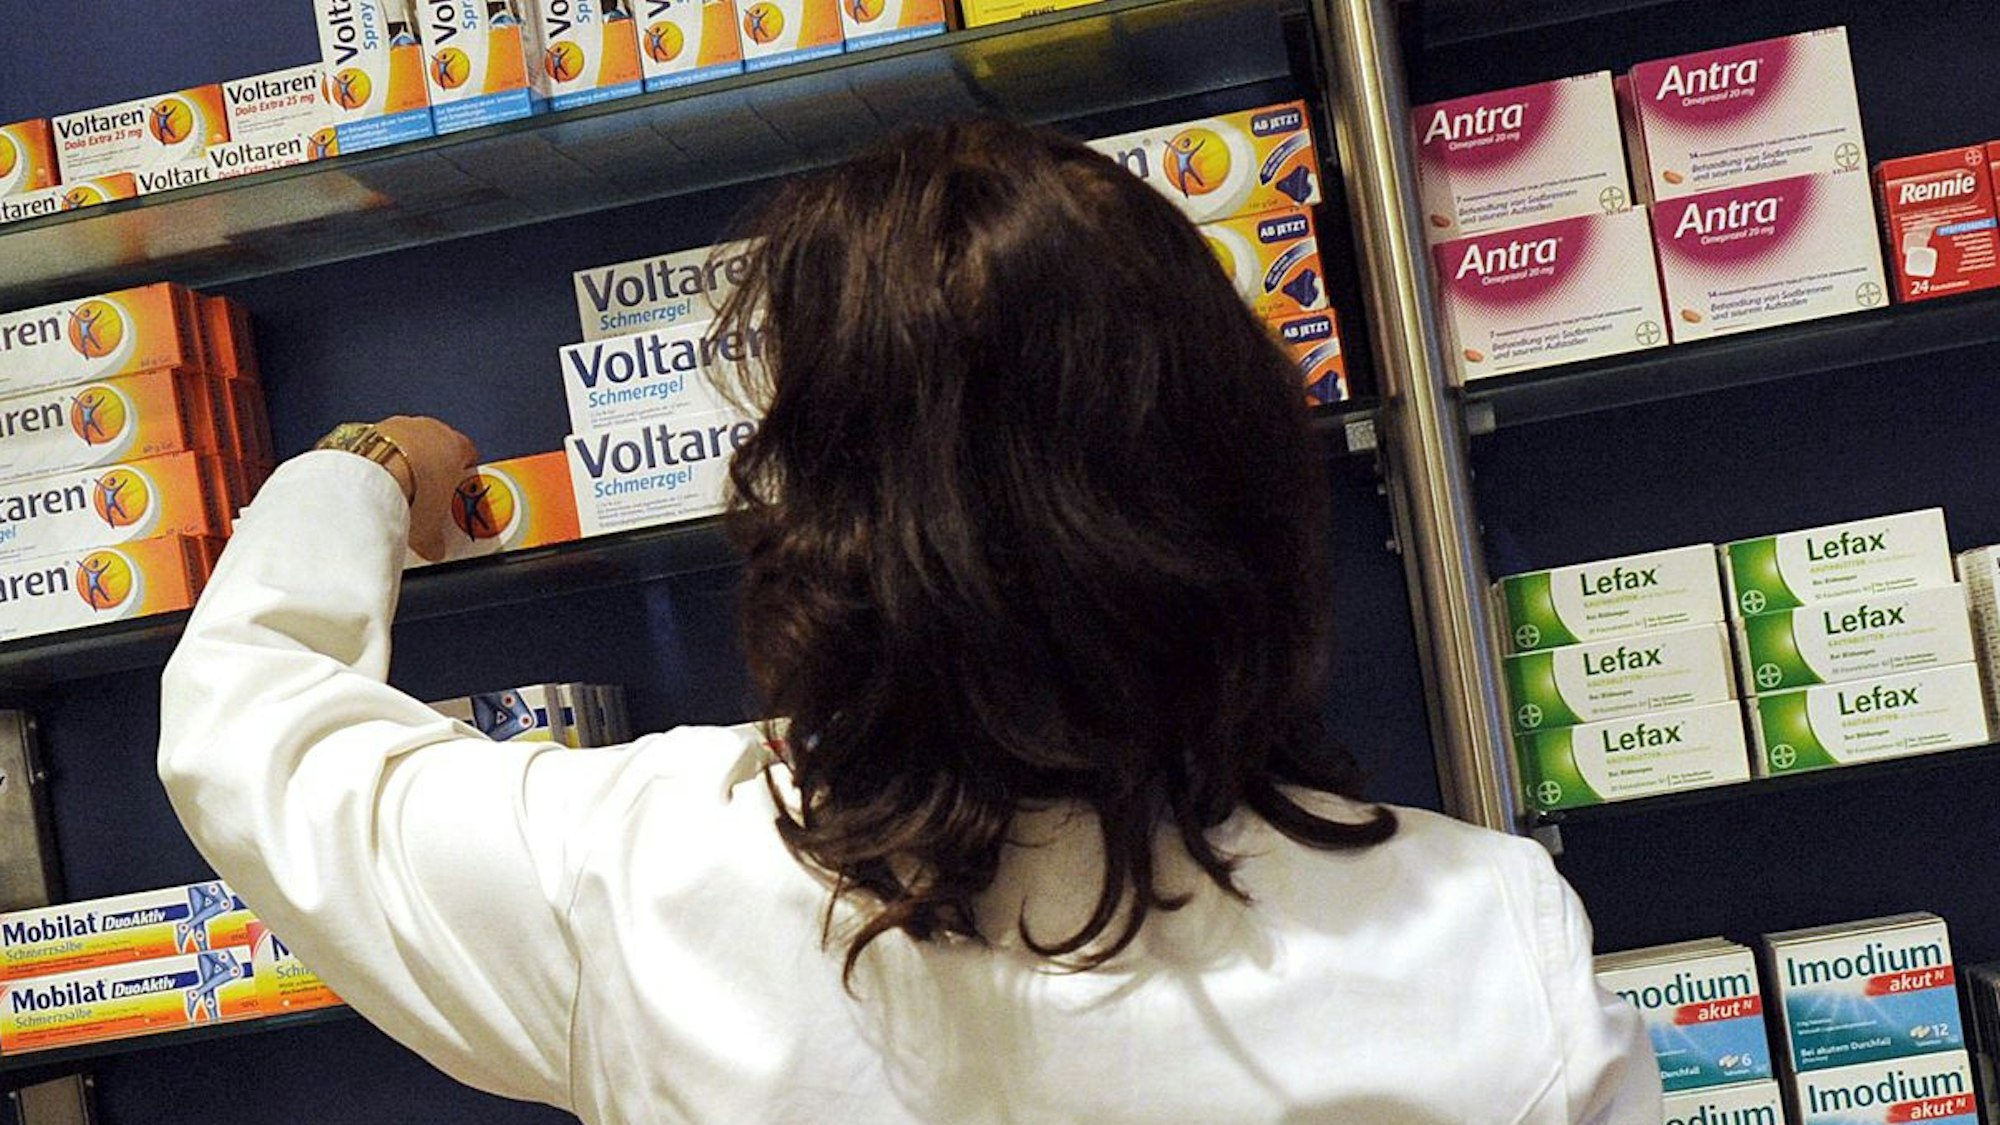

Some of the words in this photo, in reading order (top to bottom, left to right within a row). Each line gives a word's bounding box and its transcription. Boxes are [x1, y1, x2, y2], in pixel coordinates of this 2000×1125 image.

[360, 2, 379, 50] Spray
[462, 0, 478, 29] Spr
[328, 0, 358, 65] Volt
[228, 74, 316, 104] Voltaren
[1656, 58, 1758, 101] Antra
[260, 100, 284, 111] Extra
[287, 96, 298, 106] 25
[301, 93, 315, 104] mg
[57, 109, 144, 139] Voltaren
[88, 134, 112, 146] Extra
[115, 131, 126, 141] 25
[128, 128, 143, 139] mg
[1253, 118, 1269, 132] AB
[1271, 112, 1299, 128] JETZT
[1423, 103, 1524, 145] Antra
[210, 138, 301, 168] Voltaren
[1899, 171, 1976, 205] Rennie
[1260, 225, 1275, 238] AB
[1276, 219, 1306, 237] JETZT
[1673, 196, 1779, 240] Antra
[1455, 237, 1558, 280] Antra
[1910, 280, 1930, 295] 24
[600, 297, 691, 332] Schmerzgel
[1283, 325, 1298, 338] AB
[1299, 320, 1330, 337] JETZT
[0, 316, 61, 351] ren
[588, 374, 684, 409] Schmerzgel
[0, 402, 63, 438] ren
[594, 466, 693, 499] Schmerzgel
[1806, 531, 1886, 562] Lefax
[1579, 566, 1659, 596] Lefax
[1823, 605, 1906, 635] Lefax
[1583, 646, 1664, 676] Lefax
[1837, 685, 1920, 716] Lefax
[1602, 722, 1682, 753] Lefax
[2, 911, 97, 947] Mobilat
[105, 909, 166, 930] DuoAktiv
[5, 939, 83, 962] Schmerzsalbe
[1787, 941, 1943, 986] Imodium
[11, 978, 107, 1014] Mobilat
[114, 976, 175, 997] DuoAktiv
[1889, 972, 1932, 993] akut
[1934, 970, 1945, 981] N
[15, 1006, 92, 1030] Schmerzsalbe
[1698, 1002, 1740, 1021] akut
[1850, 1036, 1891, 1051] Durchfall
[1932, 1022, 1949, 1036] 12
[1660, 1066, 1700, 1080] Durchfall
[1741, 1053, 1752, 1067] 6
[1808, 1070, 1964, 1114] Imodium
[1666, 1104, 1776, 1125] dium
[1910, 1099, 1954, 1120] akut
